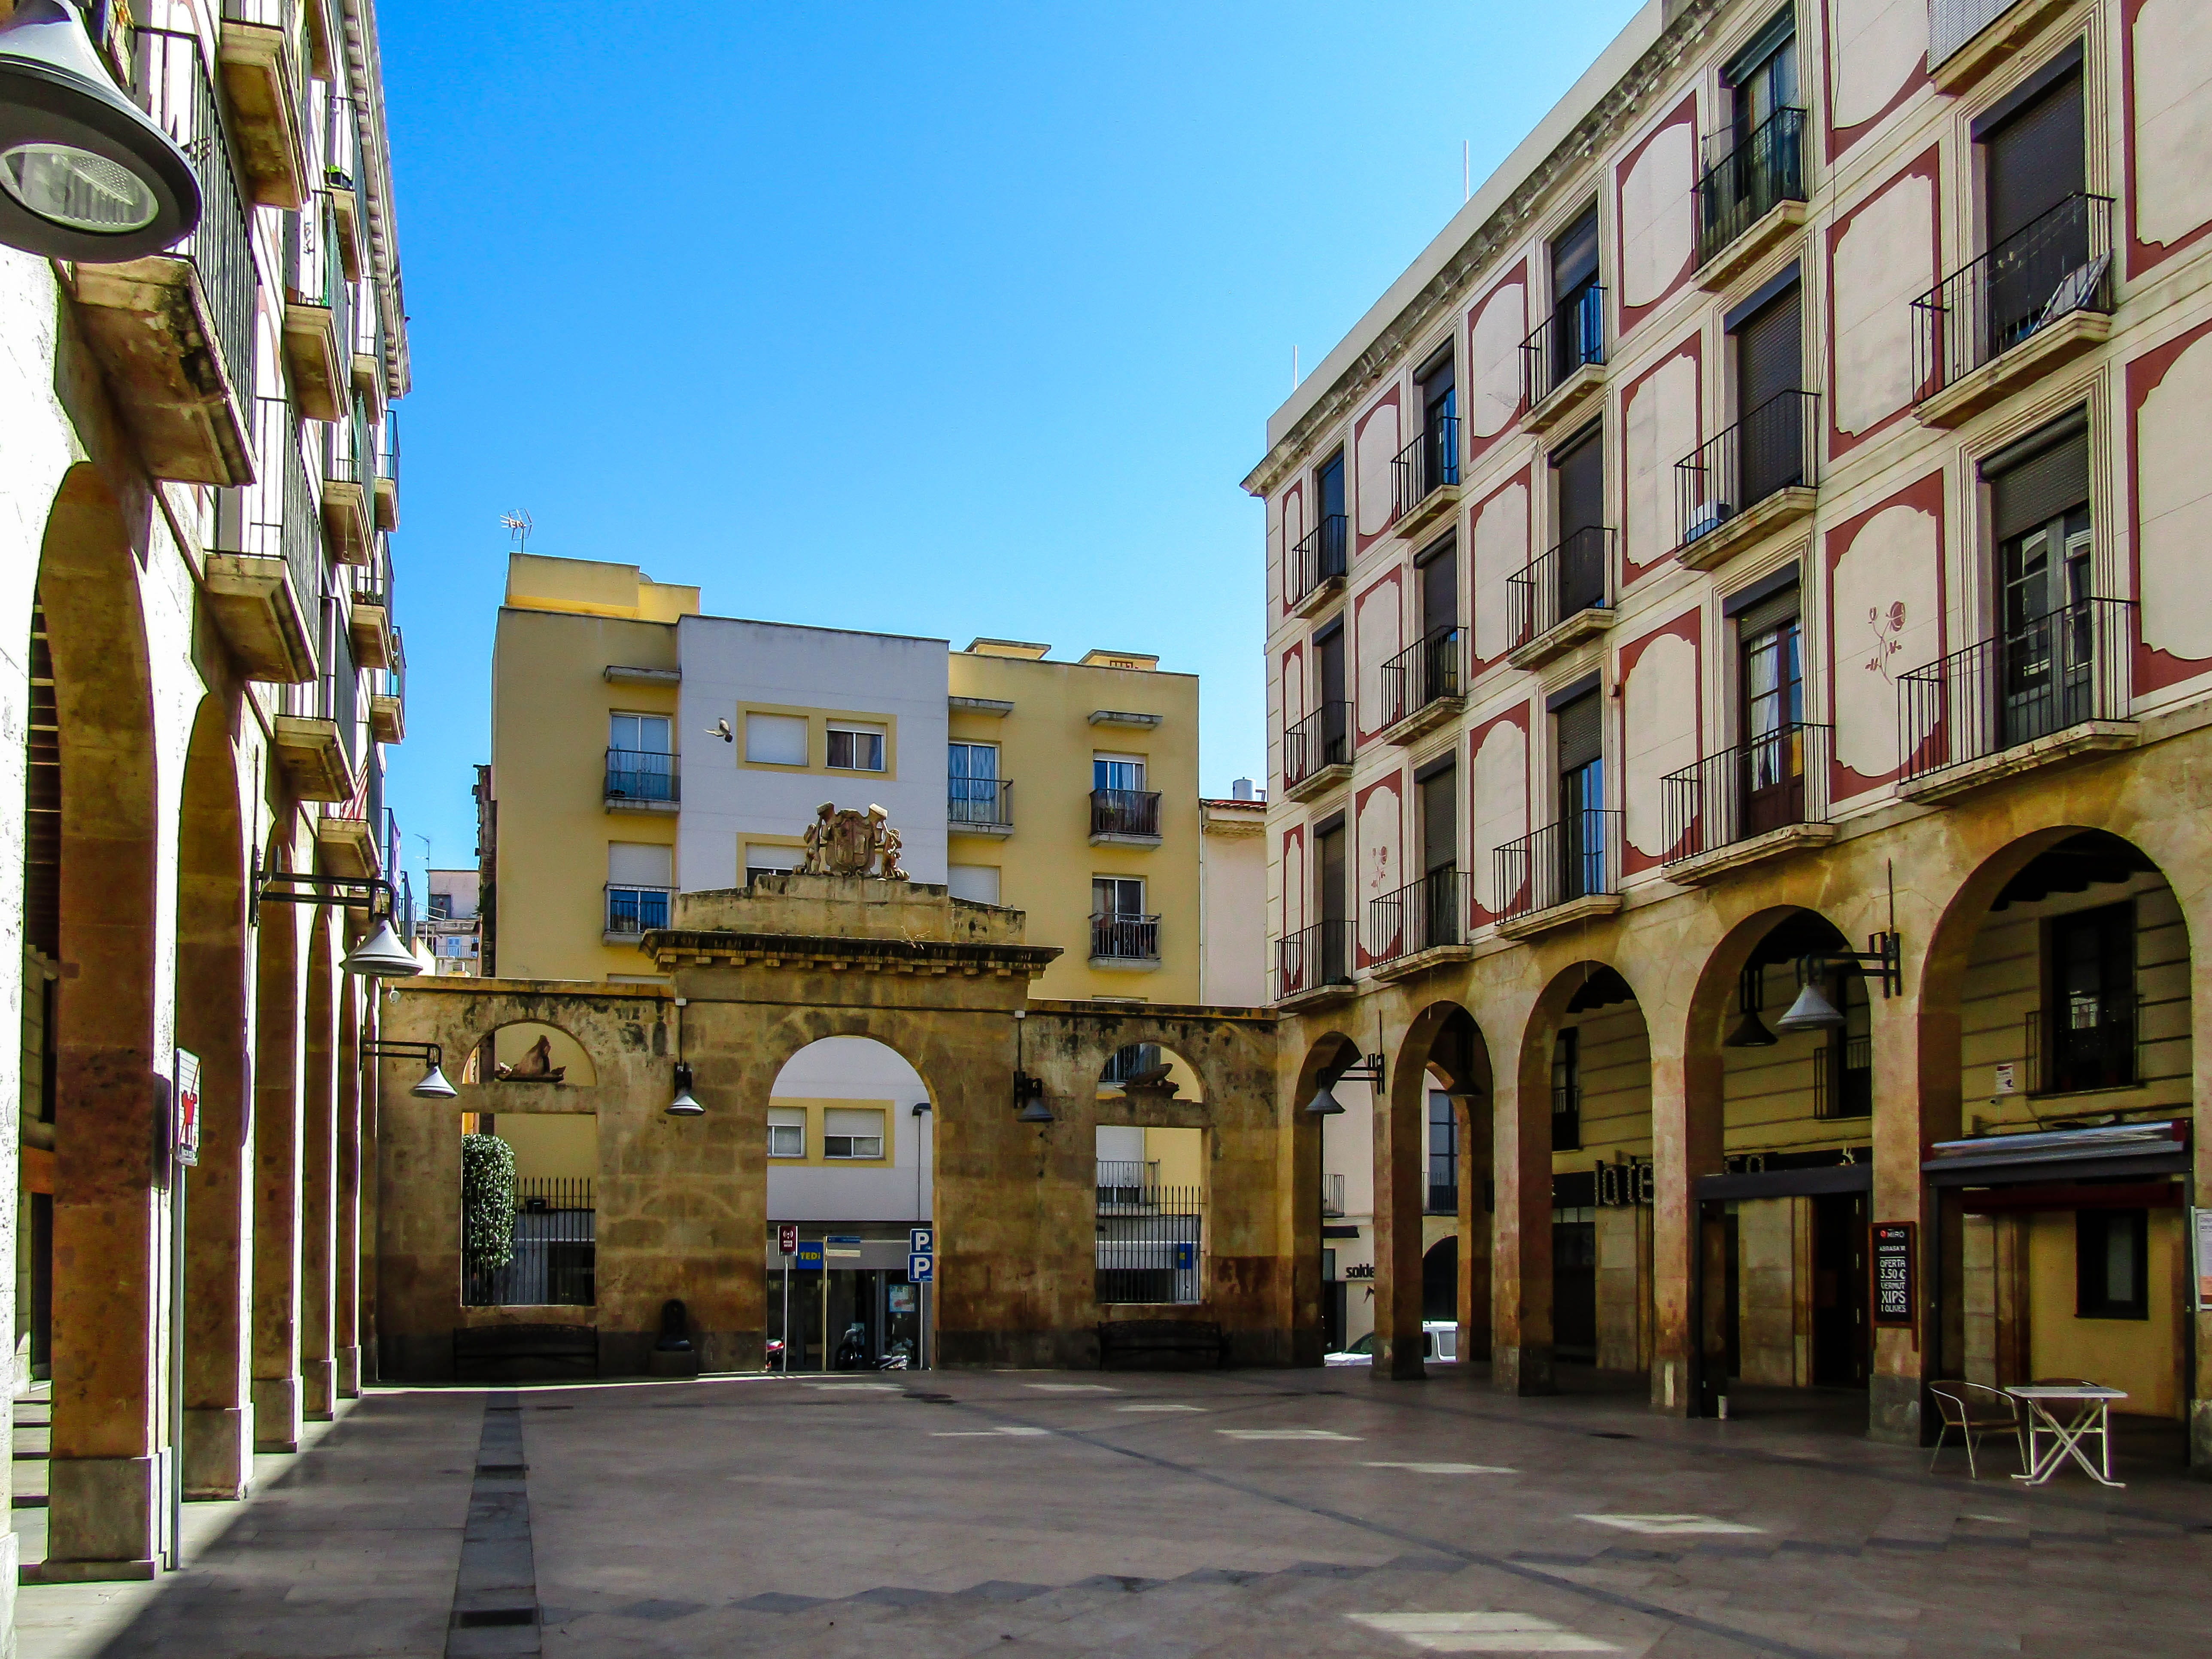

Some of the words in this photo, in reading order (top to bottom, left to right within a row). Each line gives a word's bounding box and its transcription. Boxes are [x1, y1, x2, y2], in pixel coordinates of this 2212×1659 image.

[916, 1232, 930, 1251] P
[914, 1257, 930, 1279] P
[1880, 1259, 1906, 1267] OFERTA
[1881, 1268, 1897, 1279] 3.50
[1882, 1291, 1906, 1304] XIPS
